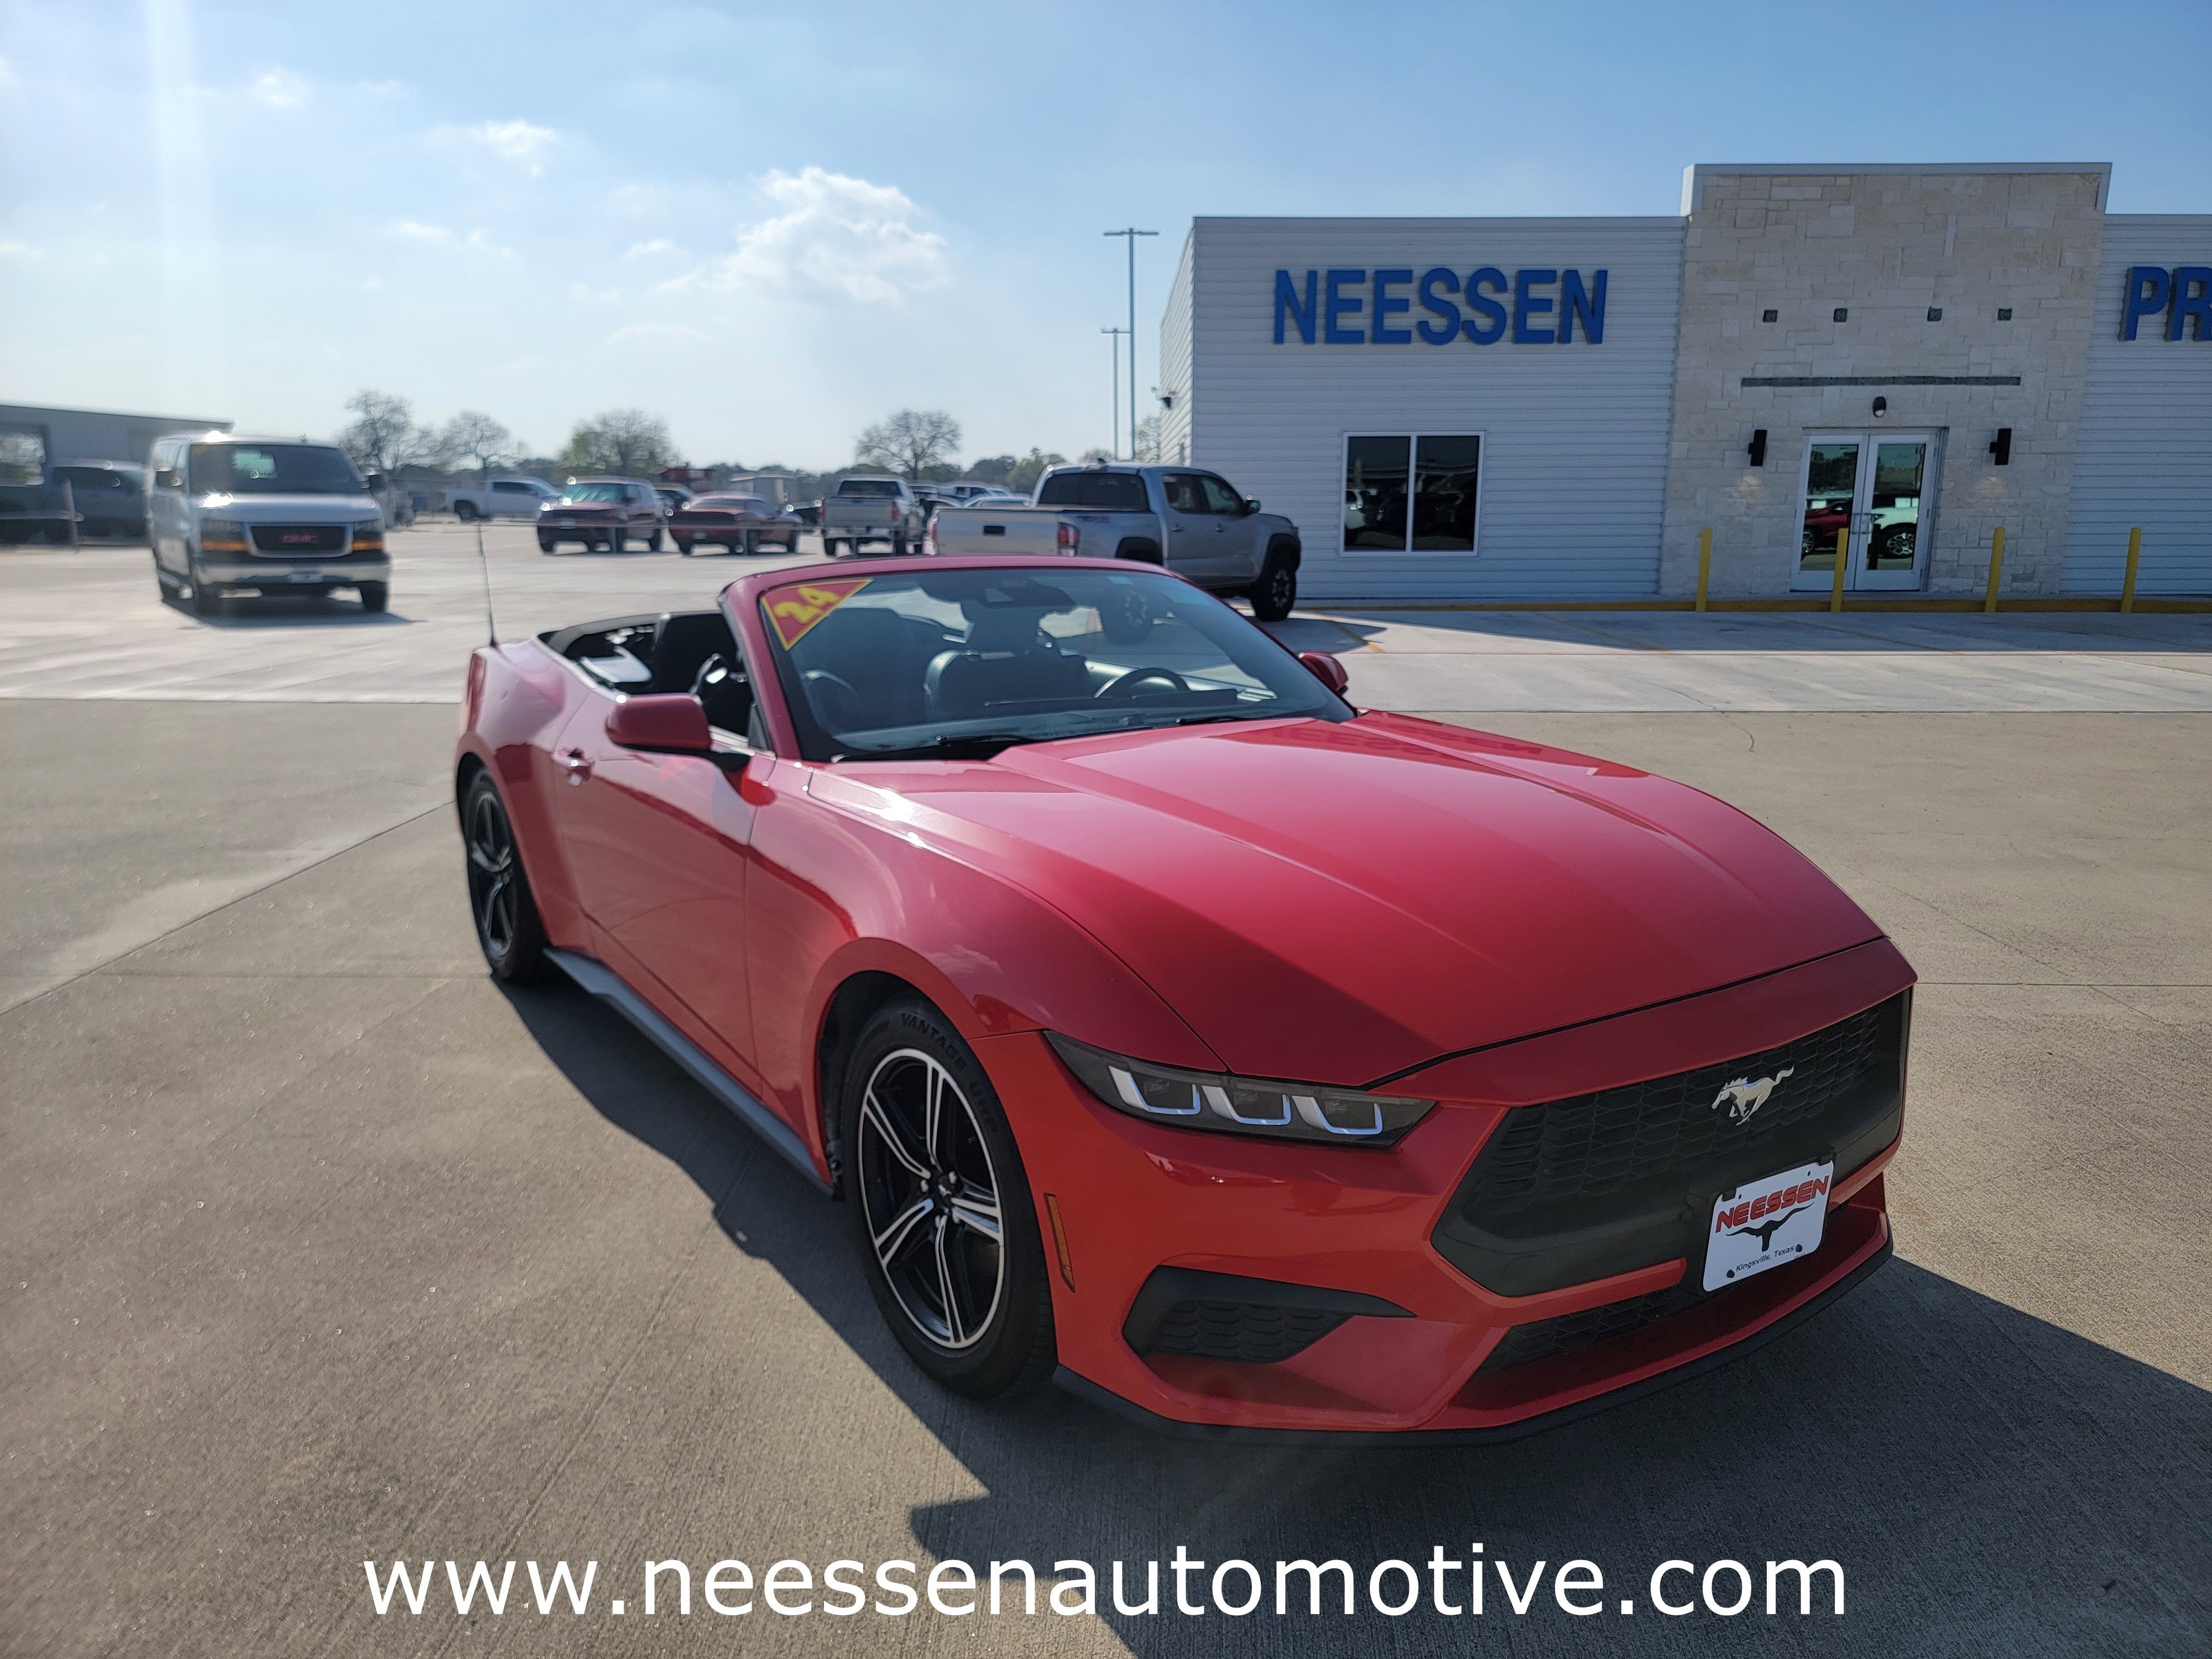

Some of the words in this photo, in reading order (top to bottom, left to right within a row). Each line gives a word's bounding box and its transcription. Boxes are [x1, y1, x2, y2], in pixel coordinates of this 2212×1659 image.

[1274, 268, 1608, 346] NEESSEN
[774, 586, 839, 624] 24
[1715, 1175, 1829, 1233] NEESSEN
[1773, 1245, 1794, 1258] Texas
